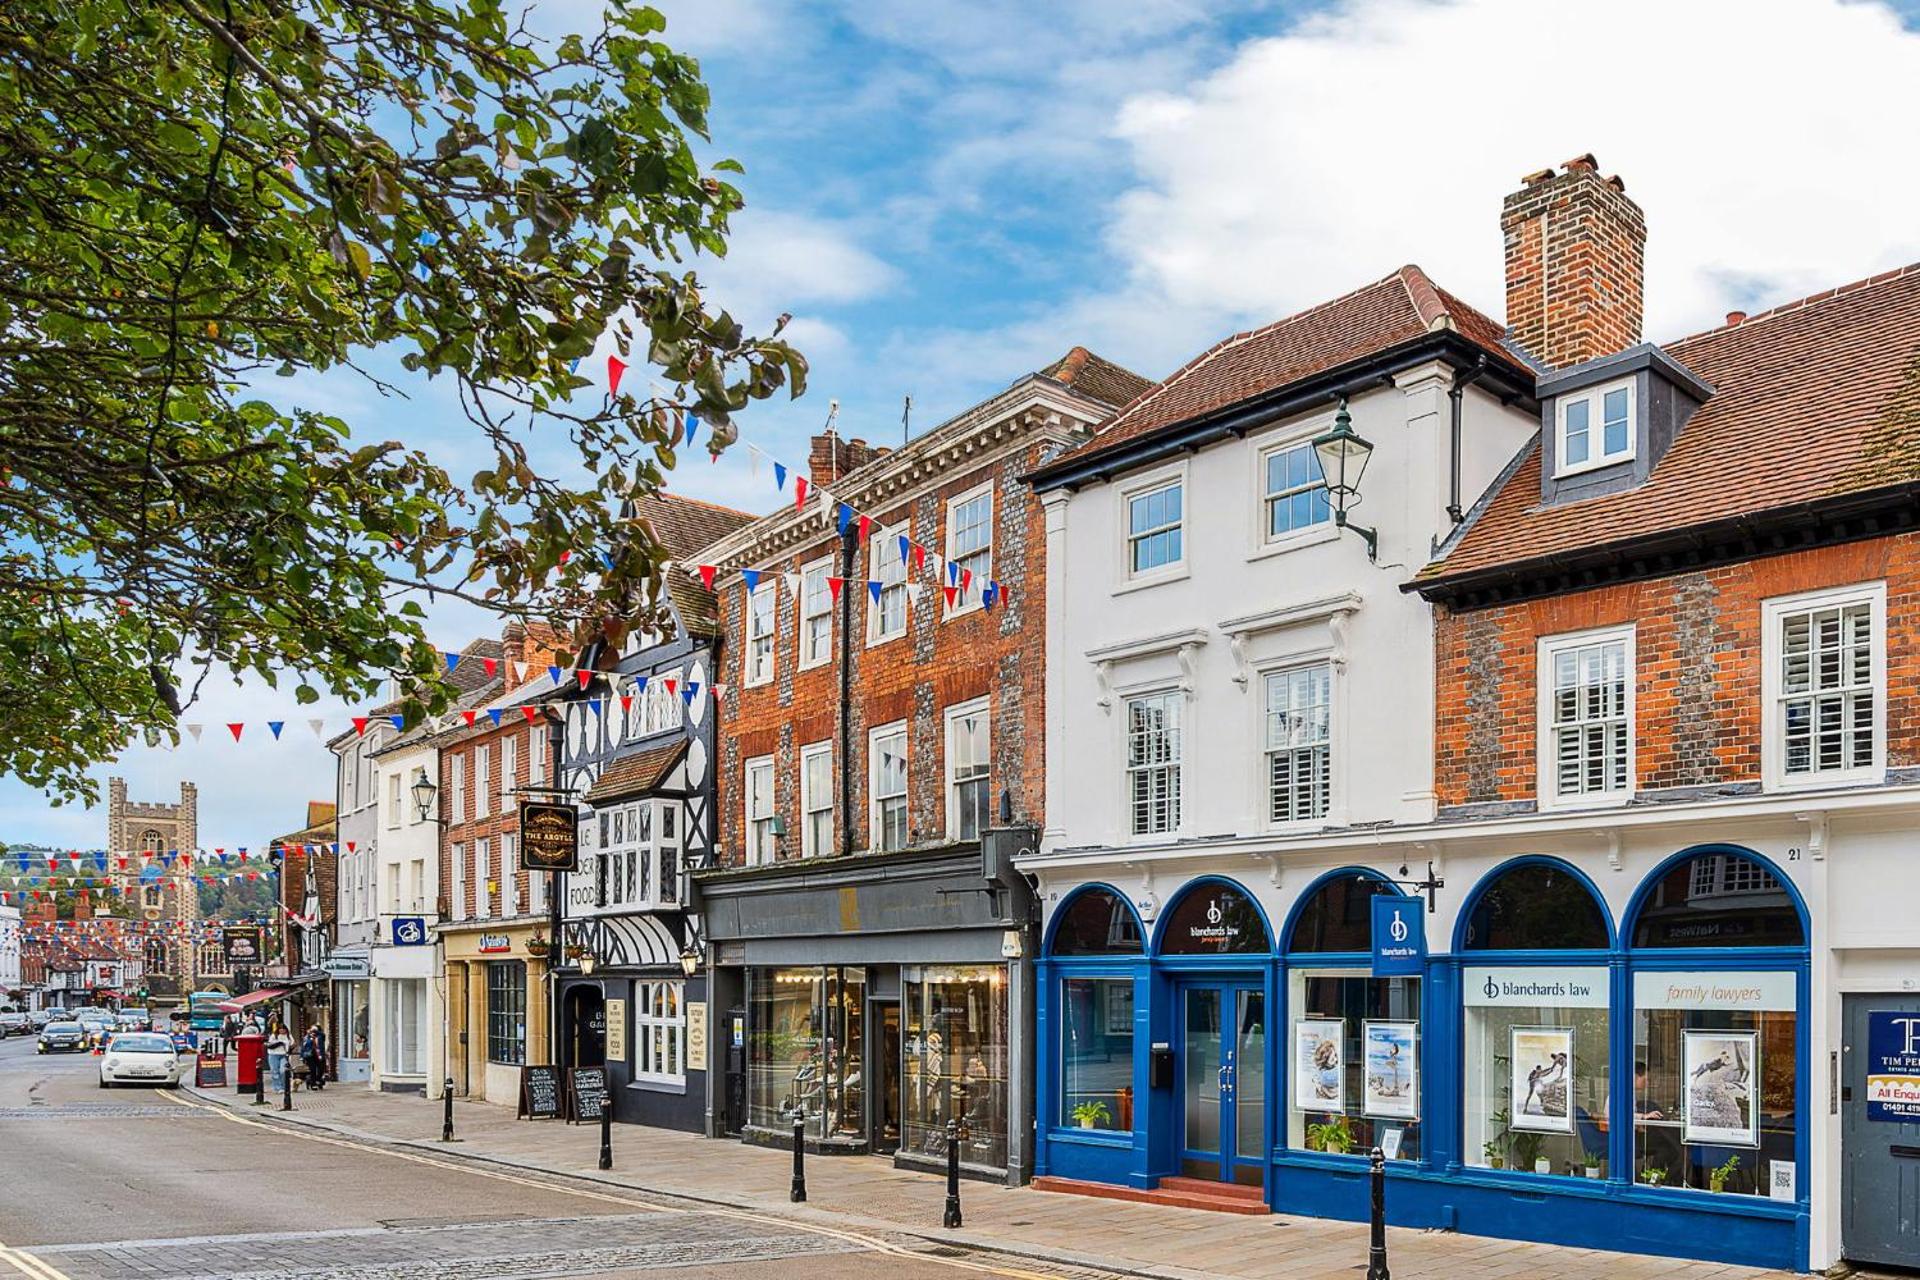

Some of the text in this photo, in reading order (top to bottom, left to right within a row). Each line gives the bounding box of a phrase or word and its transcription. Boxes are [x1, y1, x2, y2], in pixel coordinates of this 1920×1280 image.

[544, 833, 574, 841] ARGYLL
[581, 829, 591, 846] LE
[1788, 848, 1800, 860] 21
[571, 886, 594, 905] FOOD
[1050, 892, 1057, 901] 19
[1190, 926, 1239, 936] blanchards law
[1503, 982, 1591, 996] blanchards law
[1666, 985, 1762, 1004] family lawyers
[1881, 1056, 1920, 1067] TIM PE
[1878, 1088, 1890, 1097] All
